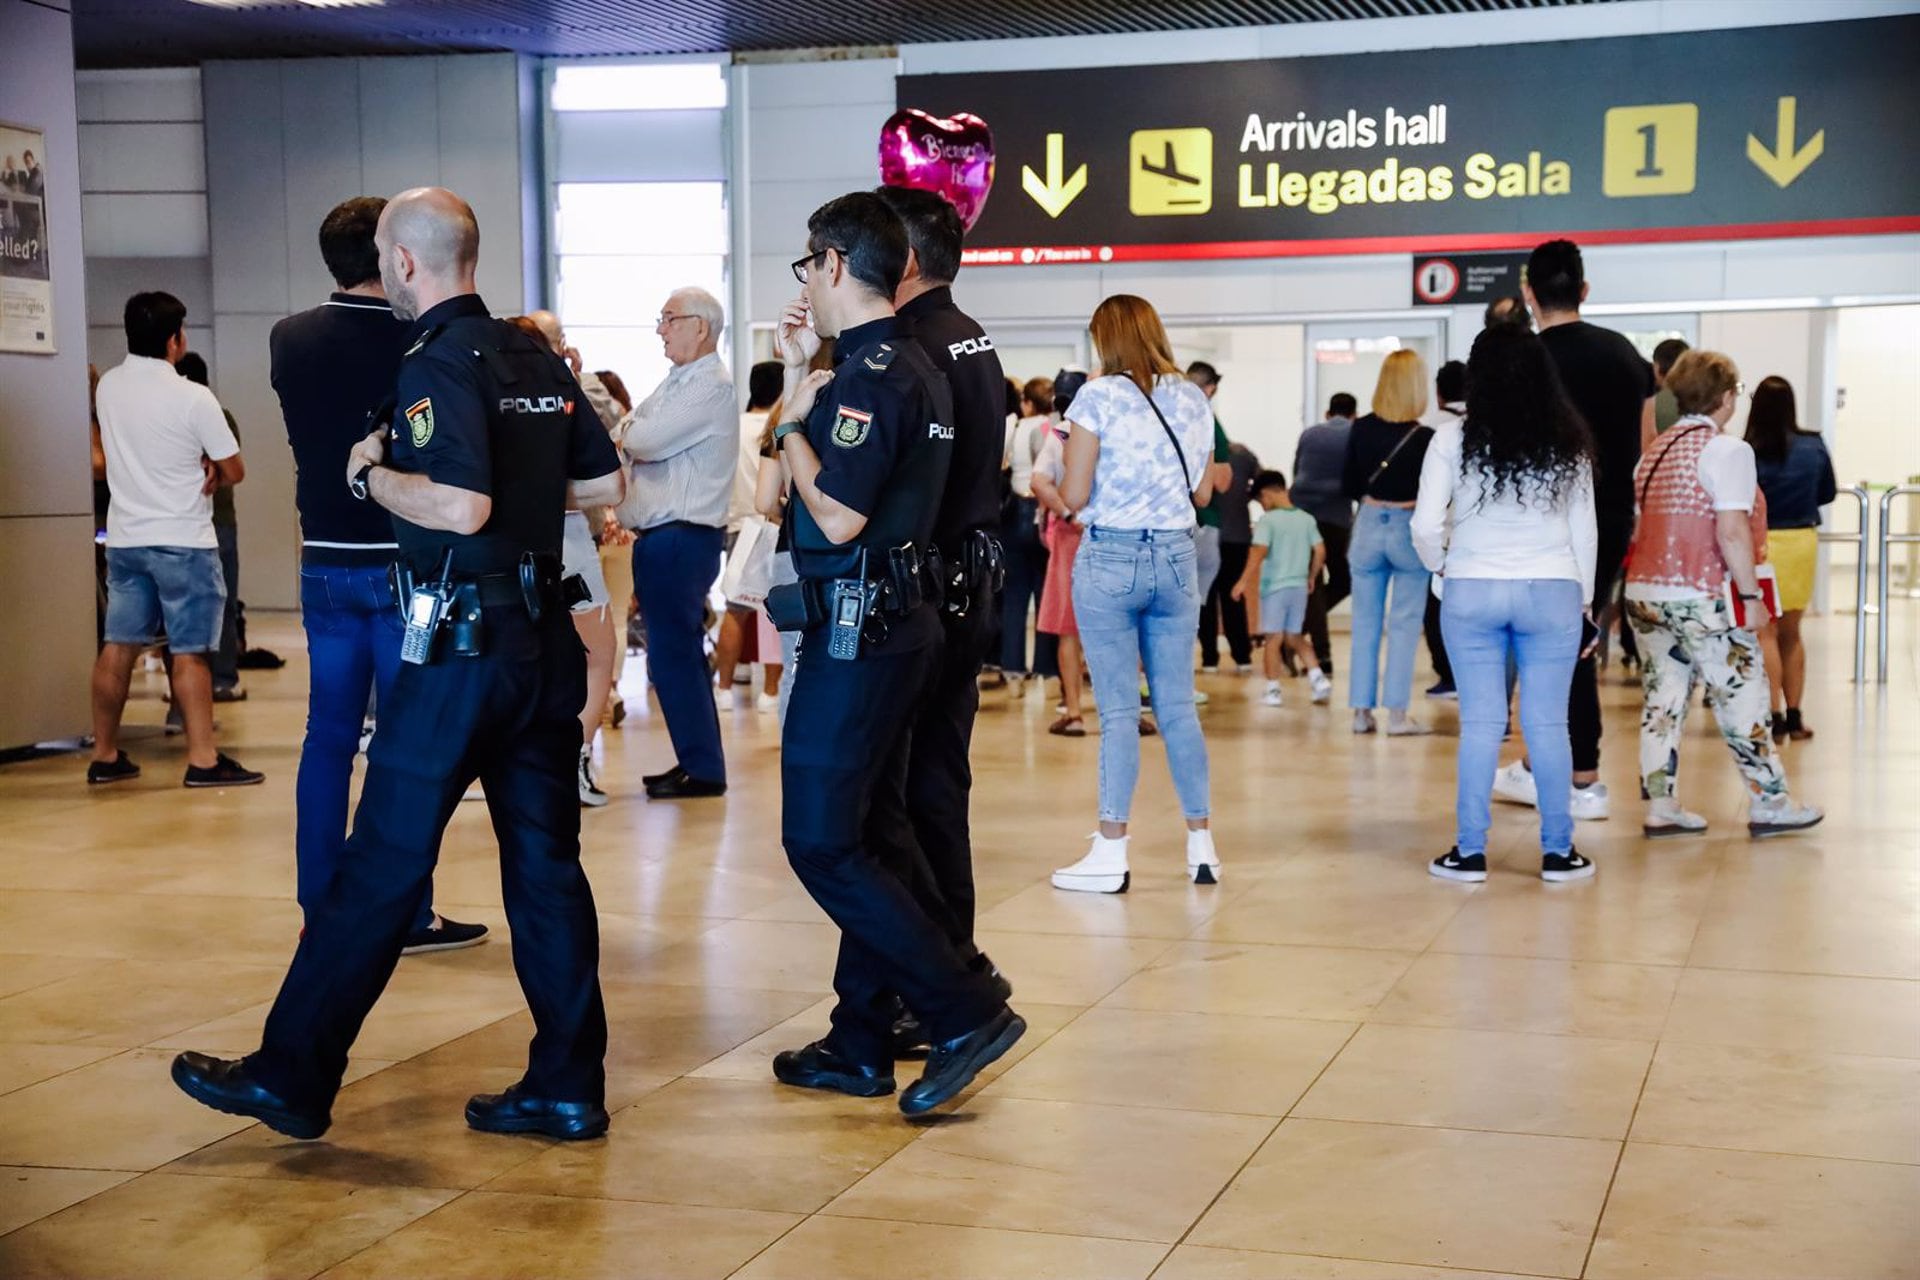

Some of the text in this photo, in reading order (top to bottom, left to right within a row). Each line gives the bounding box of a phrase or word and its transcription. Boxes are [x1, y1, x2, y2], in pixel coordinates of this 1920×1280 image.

[1240, 104, 1446, 152] Arrivals hall
[1635, 123, 1664, 178] 1
[1238, 151, 1571, 214] Llegadas Sala
[499, 395, 565, 414] POLICIA
